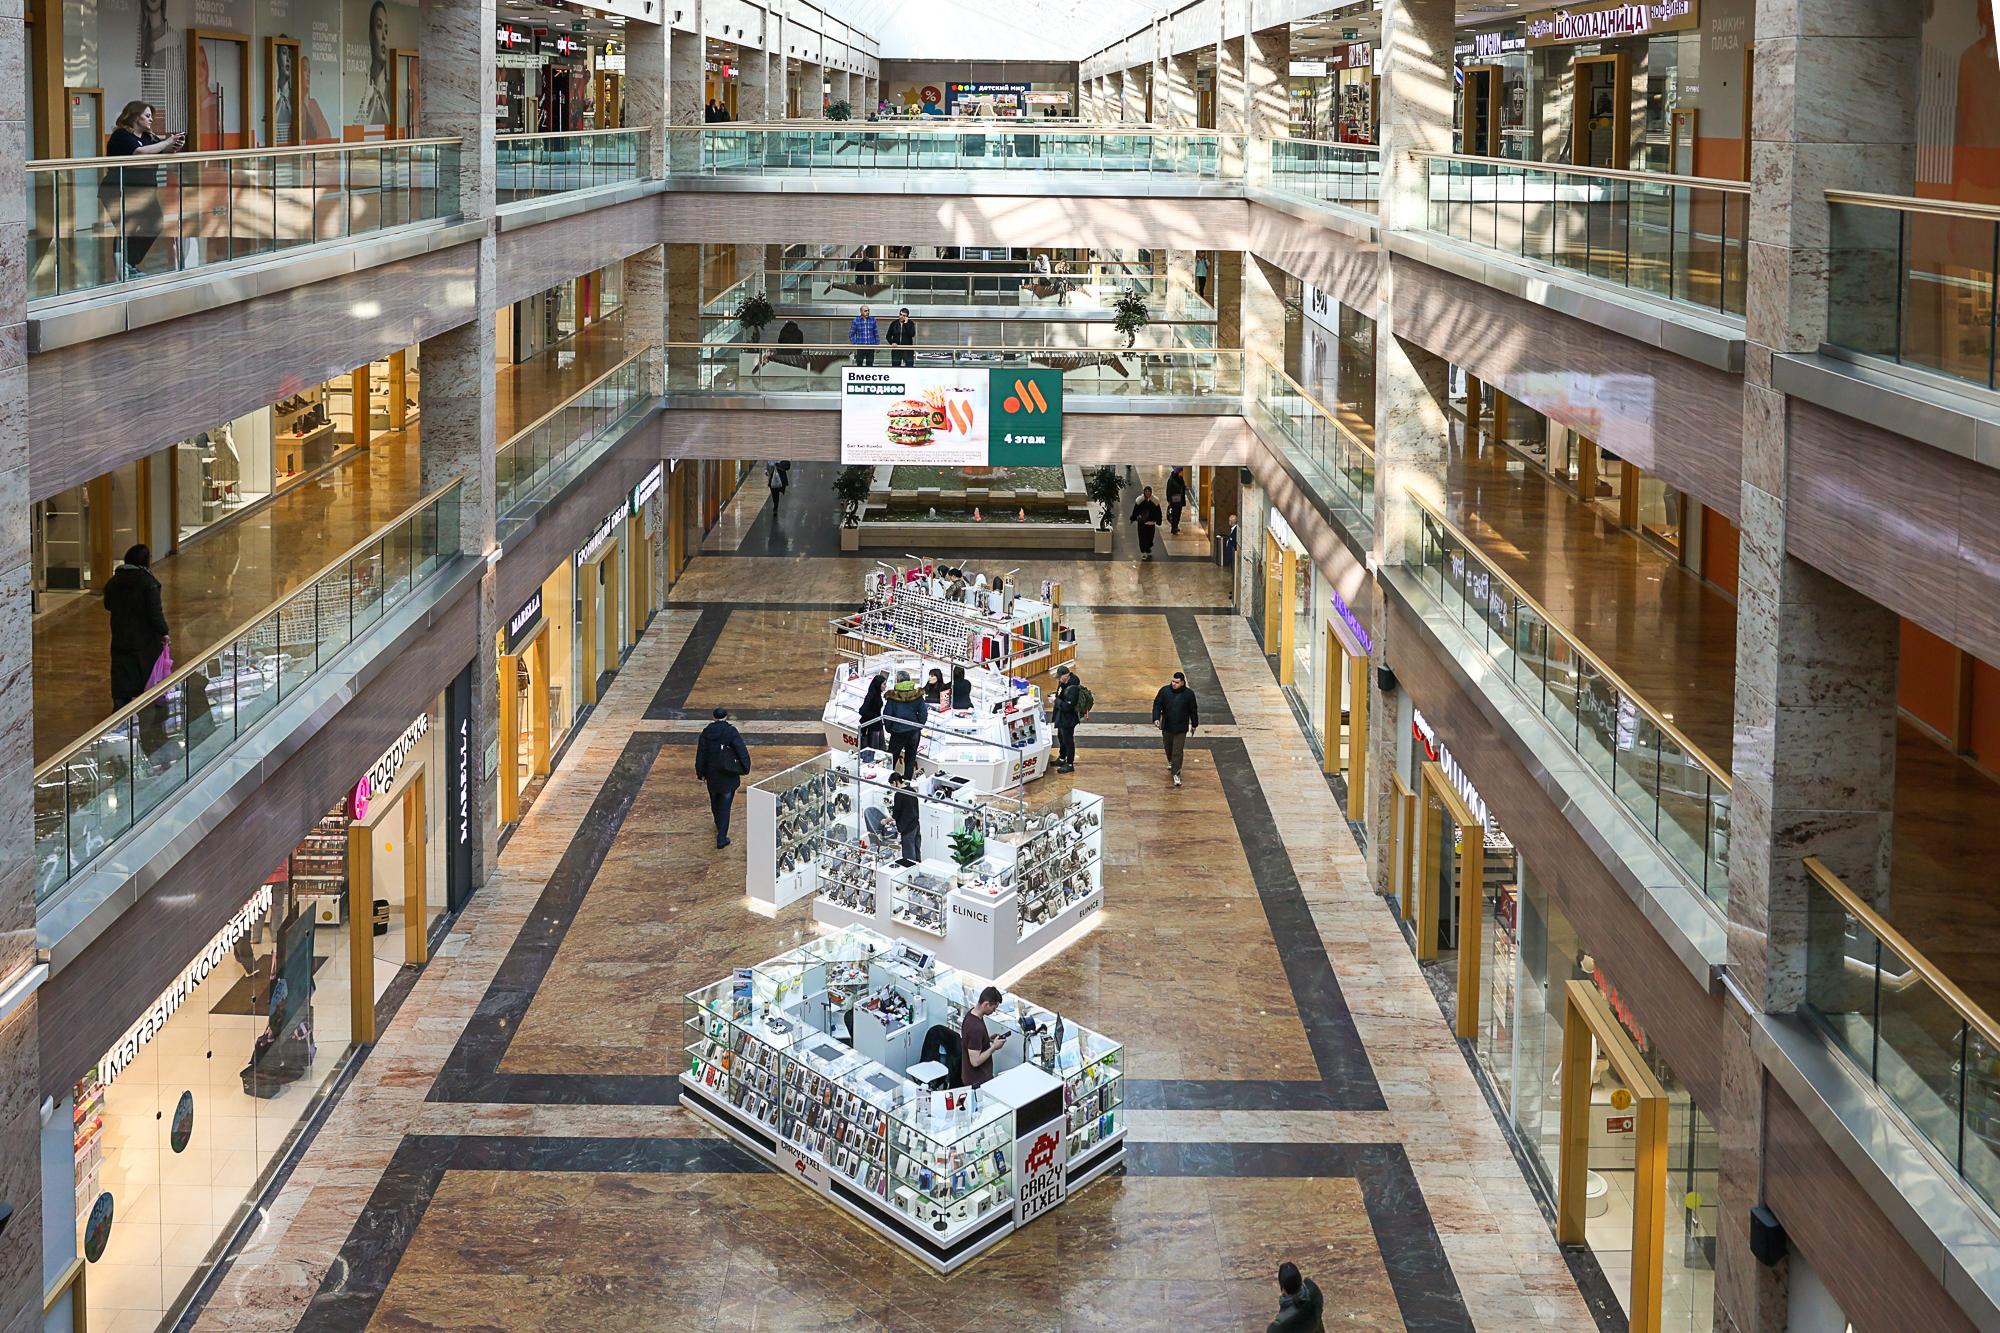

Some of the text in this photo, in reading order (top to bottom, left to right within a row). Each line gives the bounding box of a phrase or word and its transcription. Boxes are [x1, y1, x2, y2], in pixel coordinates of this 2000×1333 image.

[195, 1, 225, 13] НОВОГО
[195, 13, 233, 28] МАГАЗИНА
[1554, 5, 1646, 40] ШОКОЛАДНИЦА
[312, 42, 333, 52] НОВОГО
[1475, 32, 1501, 56] TOPGUN
[1711, 35, 1739, 50] ПЛАЗА
[312, 52, 338, 63] МАГАЗИНА
[346, 59, 367, 72] ПЛАЗА
[848, 372, 890, 381] Вместе
[847, 385, 905, 395] выгоднее
[1004, 433, 1046, 445] 4 этаж
[511, 594, 541, 637] MARELLA
[367, 711, 429, 801] подружка
[1022, 756, 1038, 769] 585
[460, 718, 469, 845] MARELLA
[1439, 742, 1490, 836] ОПТИКА
[952, 904, 989, 924] ELINICE
[1079, 899, 1100, 918] ELINICE
[104, 884, 274, 1086] Магазин косметики
[781, 1140, 822, 1173] CRAZY PIXEL
[1020, 1162, 1063, 1202] CRAZY
[1021, 1183, 1065, 1221] PIXEL
